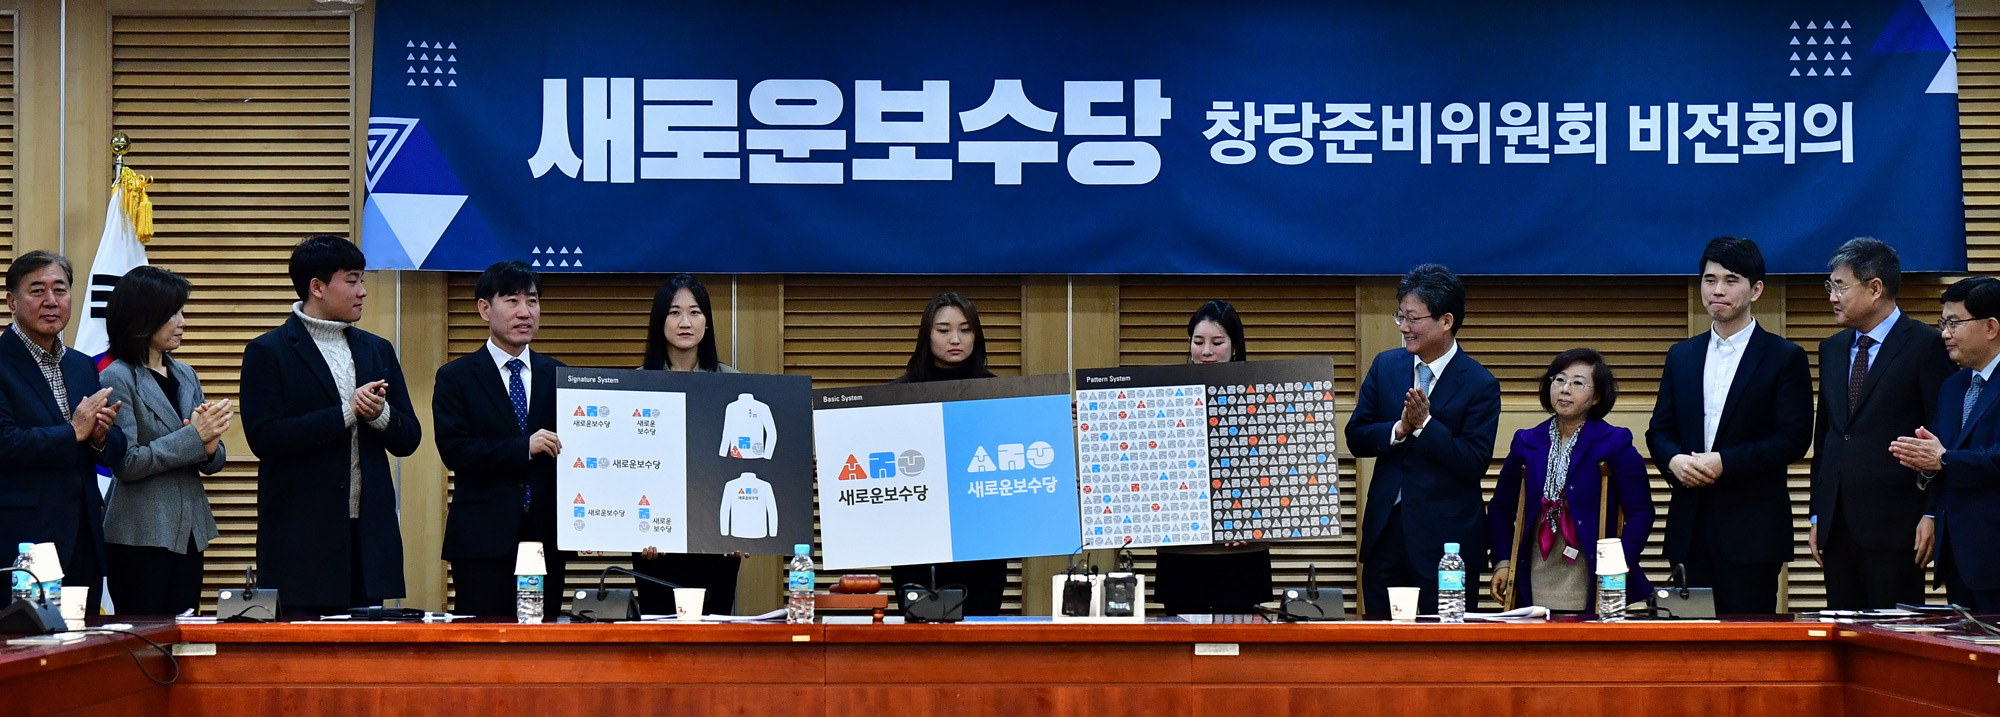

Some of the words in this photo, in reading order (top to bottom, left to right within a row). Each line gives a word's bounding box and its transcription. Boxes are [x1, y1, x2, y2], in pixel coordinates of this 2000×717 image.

[527, 77, 1172, 186] 새로운보수당
[1202, 100, 1607, 165] 창당준비위원회
[1628, 100, 1854, 165] 비전회의
[567, 375, 597, 384] Signature
[597, 376, 619, 385] System
[1086, 375, 1108, 383] Pattern
[1108, 374, 1131, 383] System
[823, 395, 841, 403] Basic
[841, 394, 863, 403] System
[572, 419, 611, 429] 새로운보수당
[636, 419, 656, 428] 새로운
[637, 427, 657, 436] 보수당
[612, 459, 661, 470] 새로운보수당
[967, 476, 1058, 498] 새로운보수당
[838, 484, 929, 506] 새로운보수당
[587, 509, 625, 518] 새로운보수당
[653, 517, 672, 526] 새로운
[653, 525, 673, 534] 보수당
